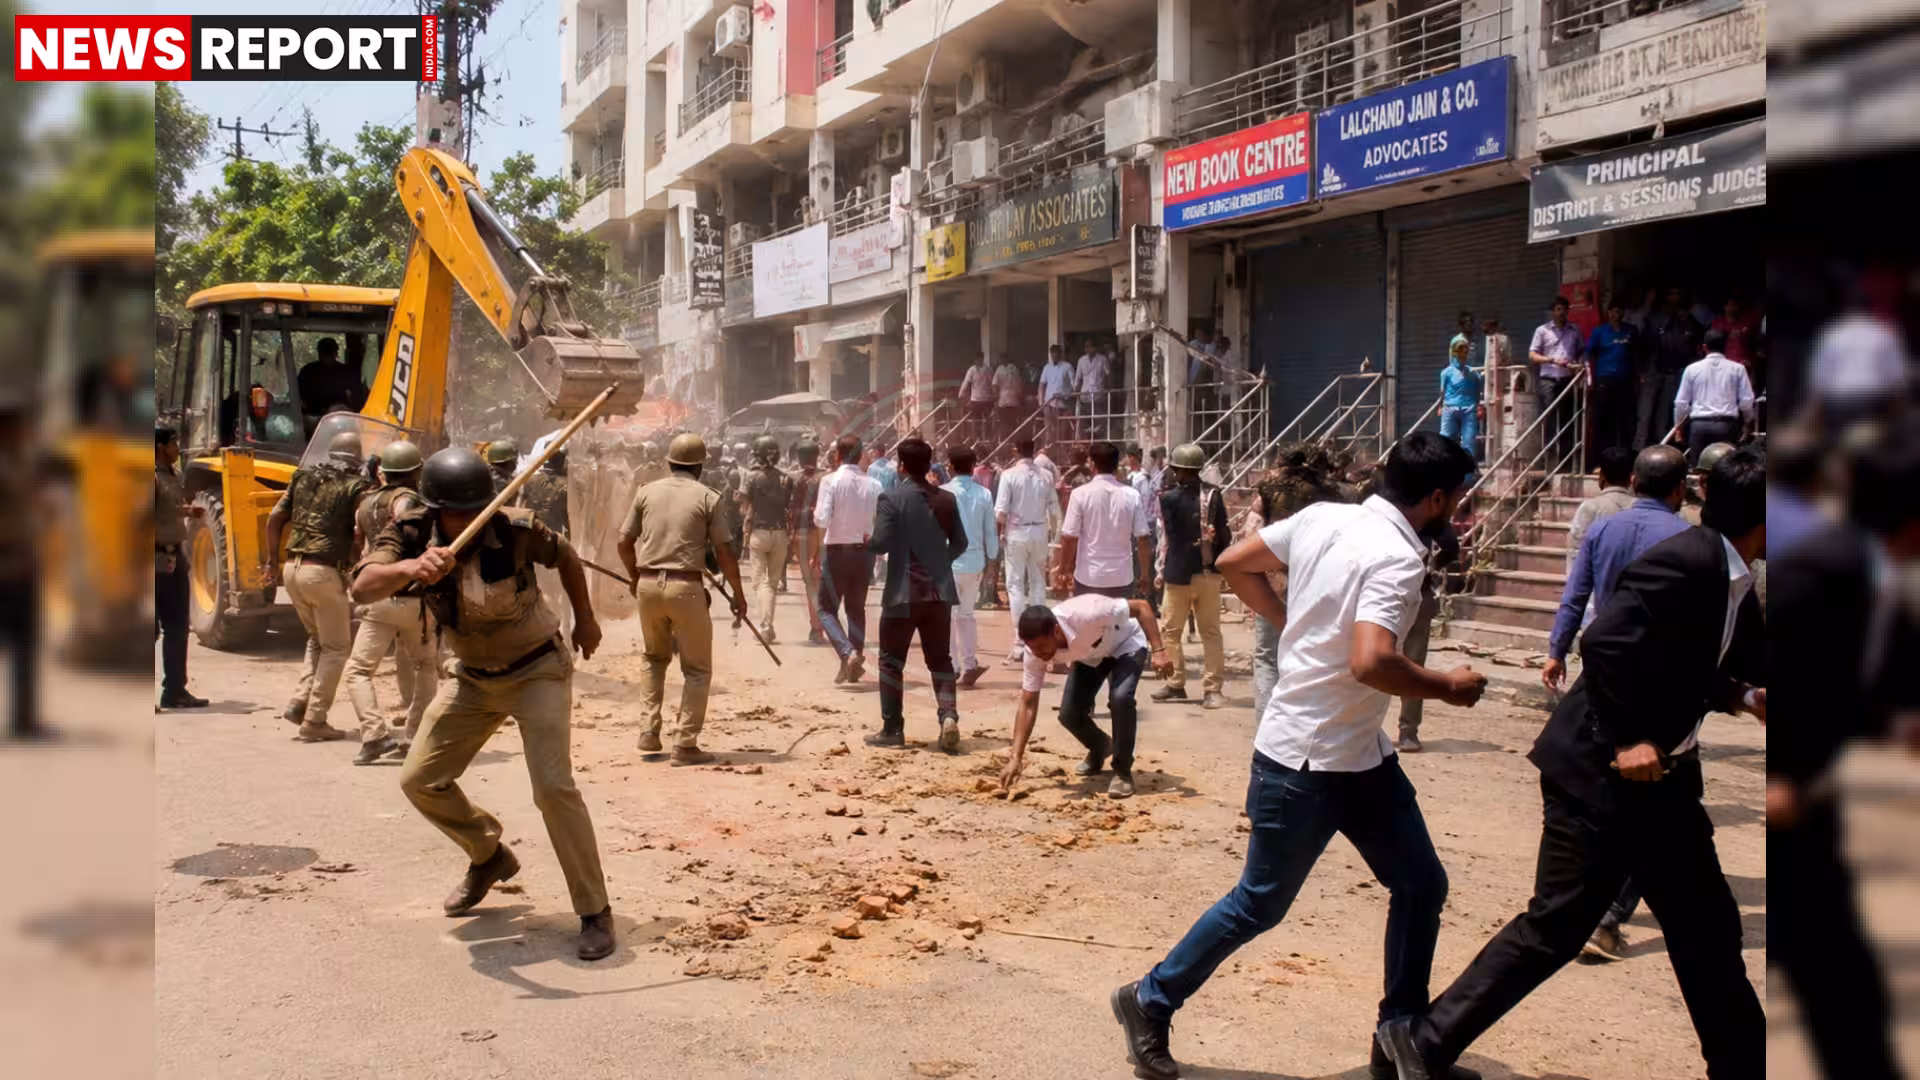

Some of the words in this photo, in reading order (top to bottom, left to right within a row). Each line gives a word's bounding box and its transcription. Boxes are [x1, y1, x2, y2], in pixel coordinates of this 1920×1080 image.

[1340, 99, 1404, 140] LALCHAND
[1407, 89, 1438, 120] JAIN
[1440, 87, 1451, 111] &
[1455, 79, 1479, 109] CO.
[1167, 160, 1197, 197] NEW
[1200, 147, 1240, 189] BOOK
[1244, 130, 1305, 177] CENTRE
[1363, 131, 1448, 169] ADVOCATES
[1586, 143, 1706, 185] PRINCIPAL
[1028, 183, 1107, 233] ASSOCIATES
[1533, 197, 1598, 227] DISTRICT
[1602, 194, 1614, 213] &
[1620, 177, 1702, 209] SESSIONS
[1707, 165, 1767, 195] JUDGE
[389, 333, 415, 424] JCB
